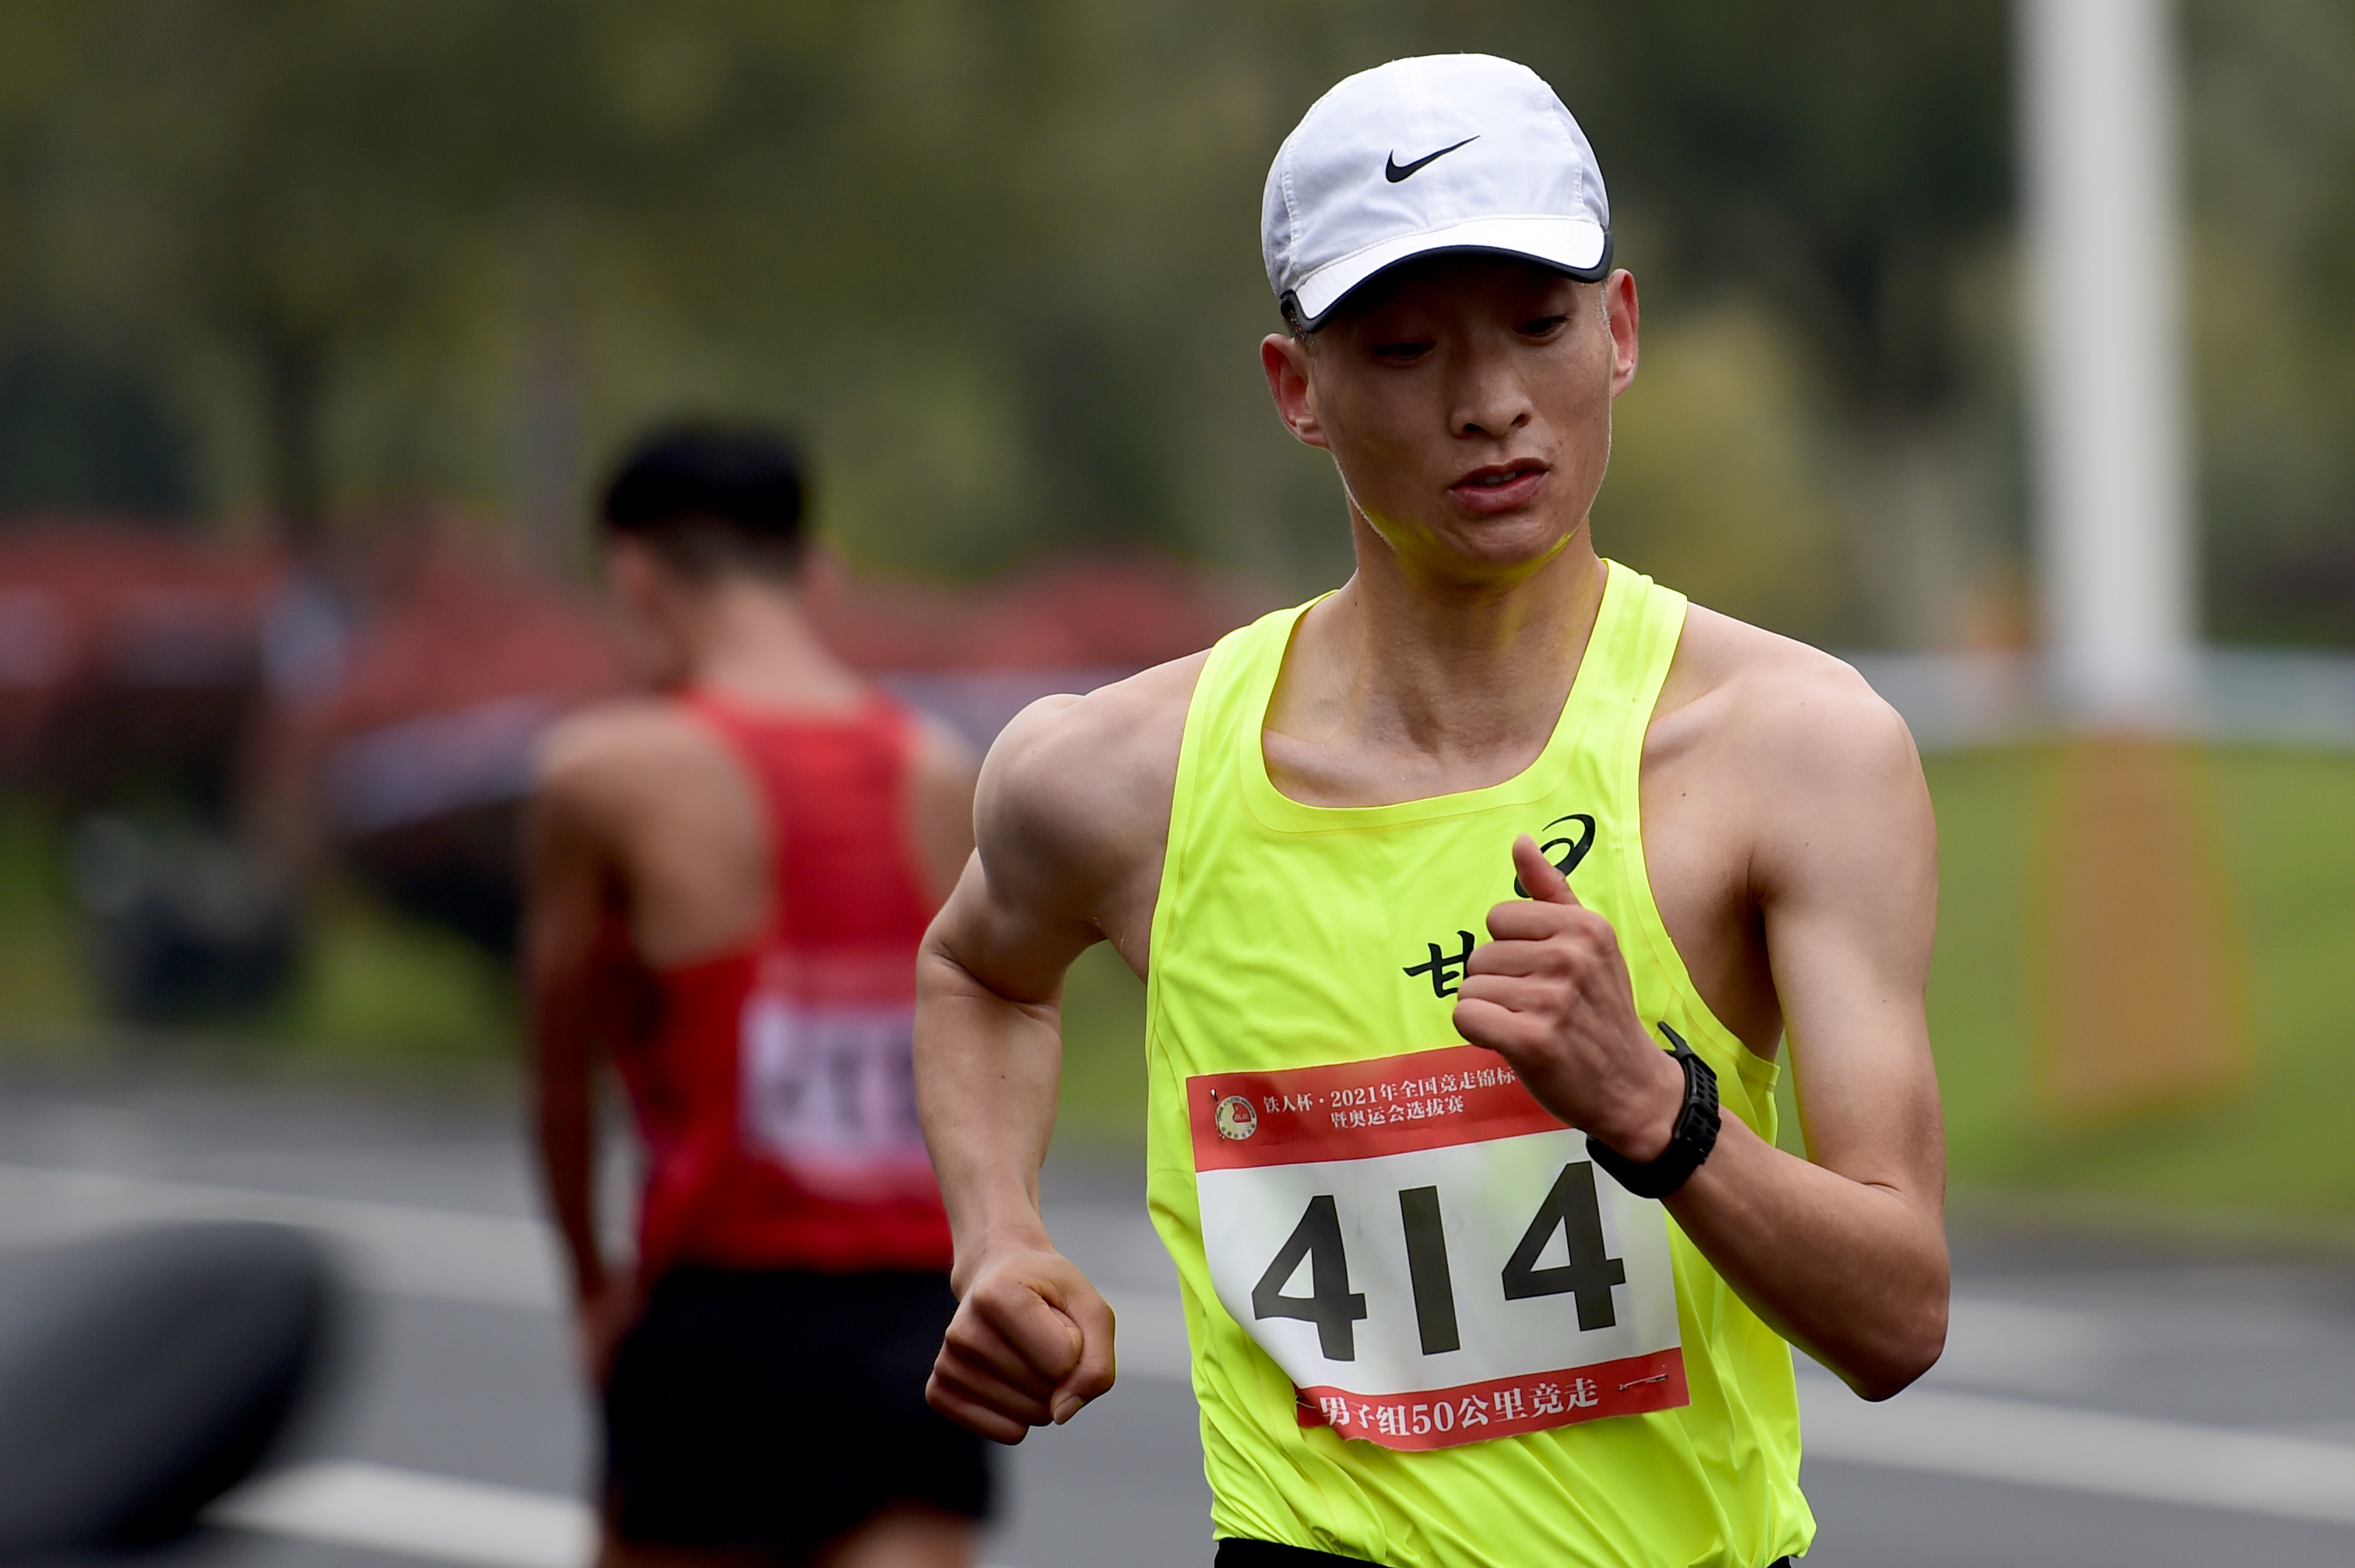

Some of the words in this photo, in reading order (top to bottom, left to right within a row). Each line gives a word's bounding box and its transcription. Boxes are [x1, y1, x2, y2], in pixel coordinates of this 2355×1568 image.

[1330, 1095, 1464, 1129] 暨奥运会选拔赛
[1251, 1160, 1626, 1362] 414
[1319, 1376, 1600, 1437] 男子组50公里竞走
